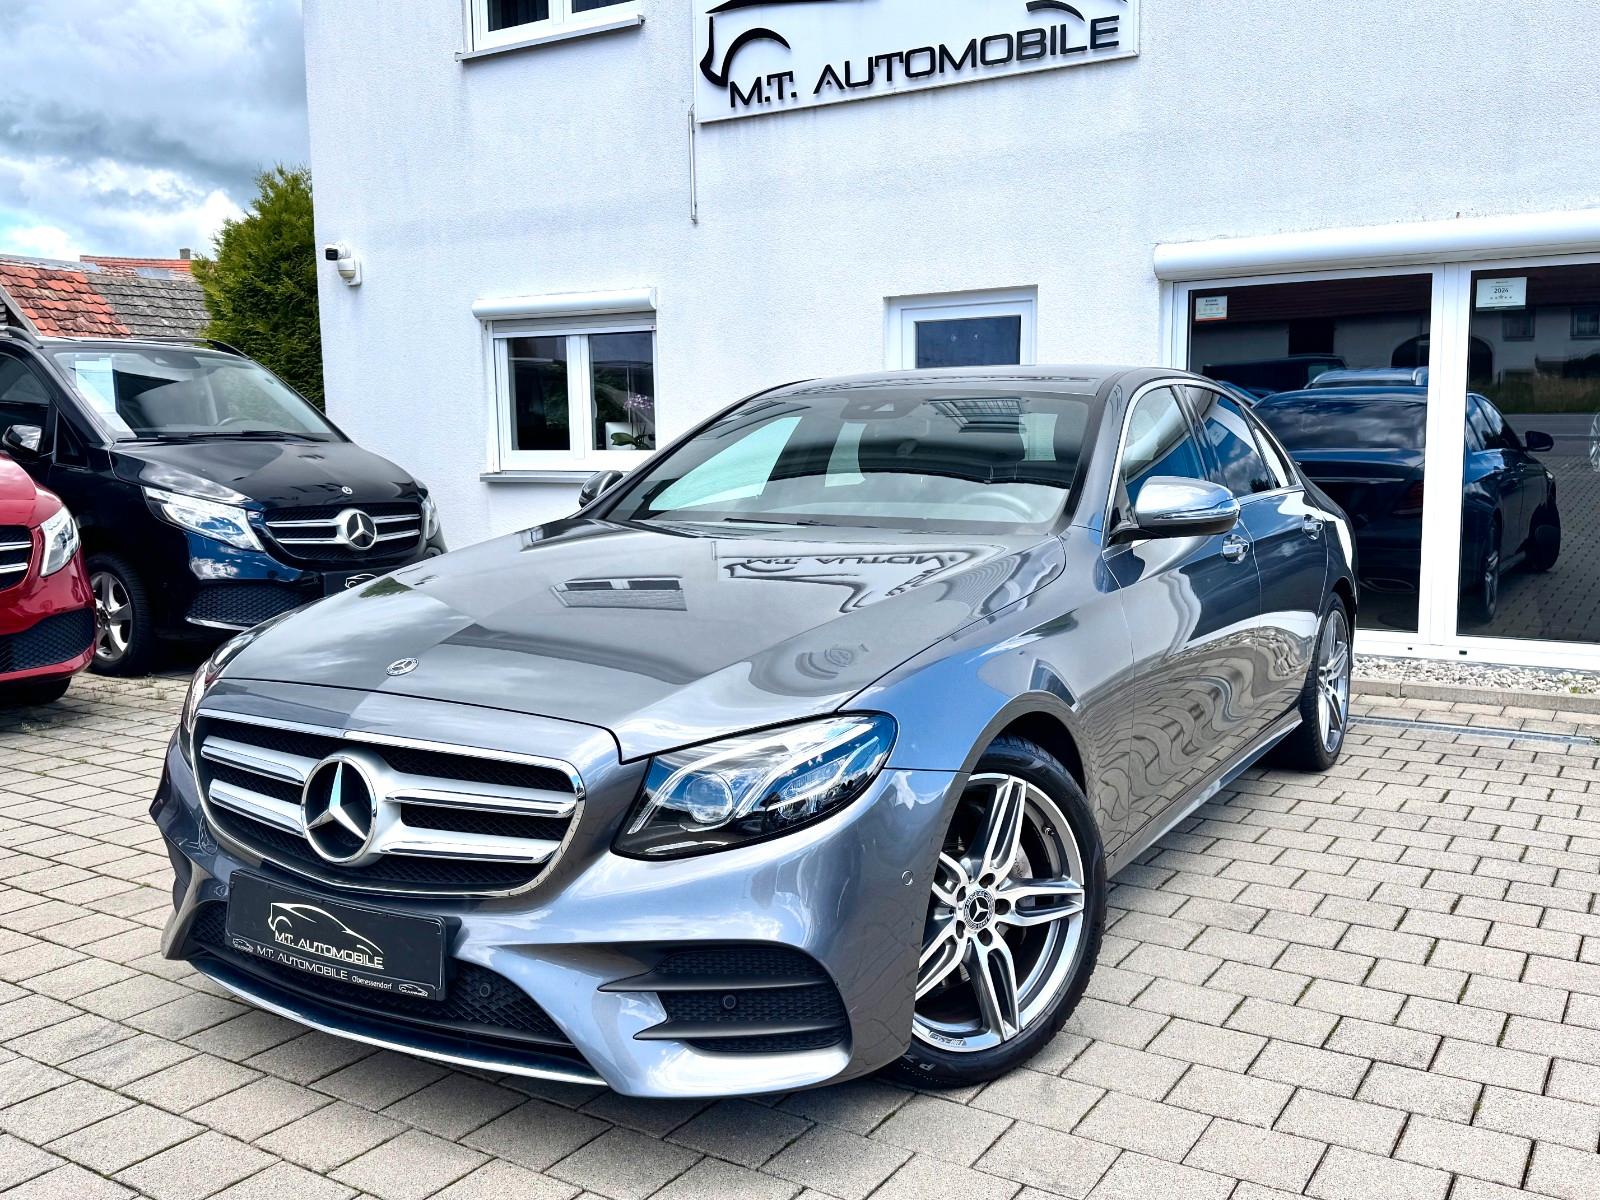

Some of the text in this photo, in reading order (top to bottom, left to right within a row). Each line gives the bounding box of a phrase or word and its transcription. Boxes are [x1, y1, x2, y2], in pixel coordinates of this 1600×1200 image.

[729, 15, 1120, 108] M.T. AUTOMOBILE
[256, 945, 275, 959] M.T.
[277, 952, 348, 980] AUTOMOBILE
[351, 975, 392, 990] Oberessendorf
[274, 930, 295, 948] M.T.
[297, 938, 384, 969] AUTOMOBILE
